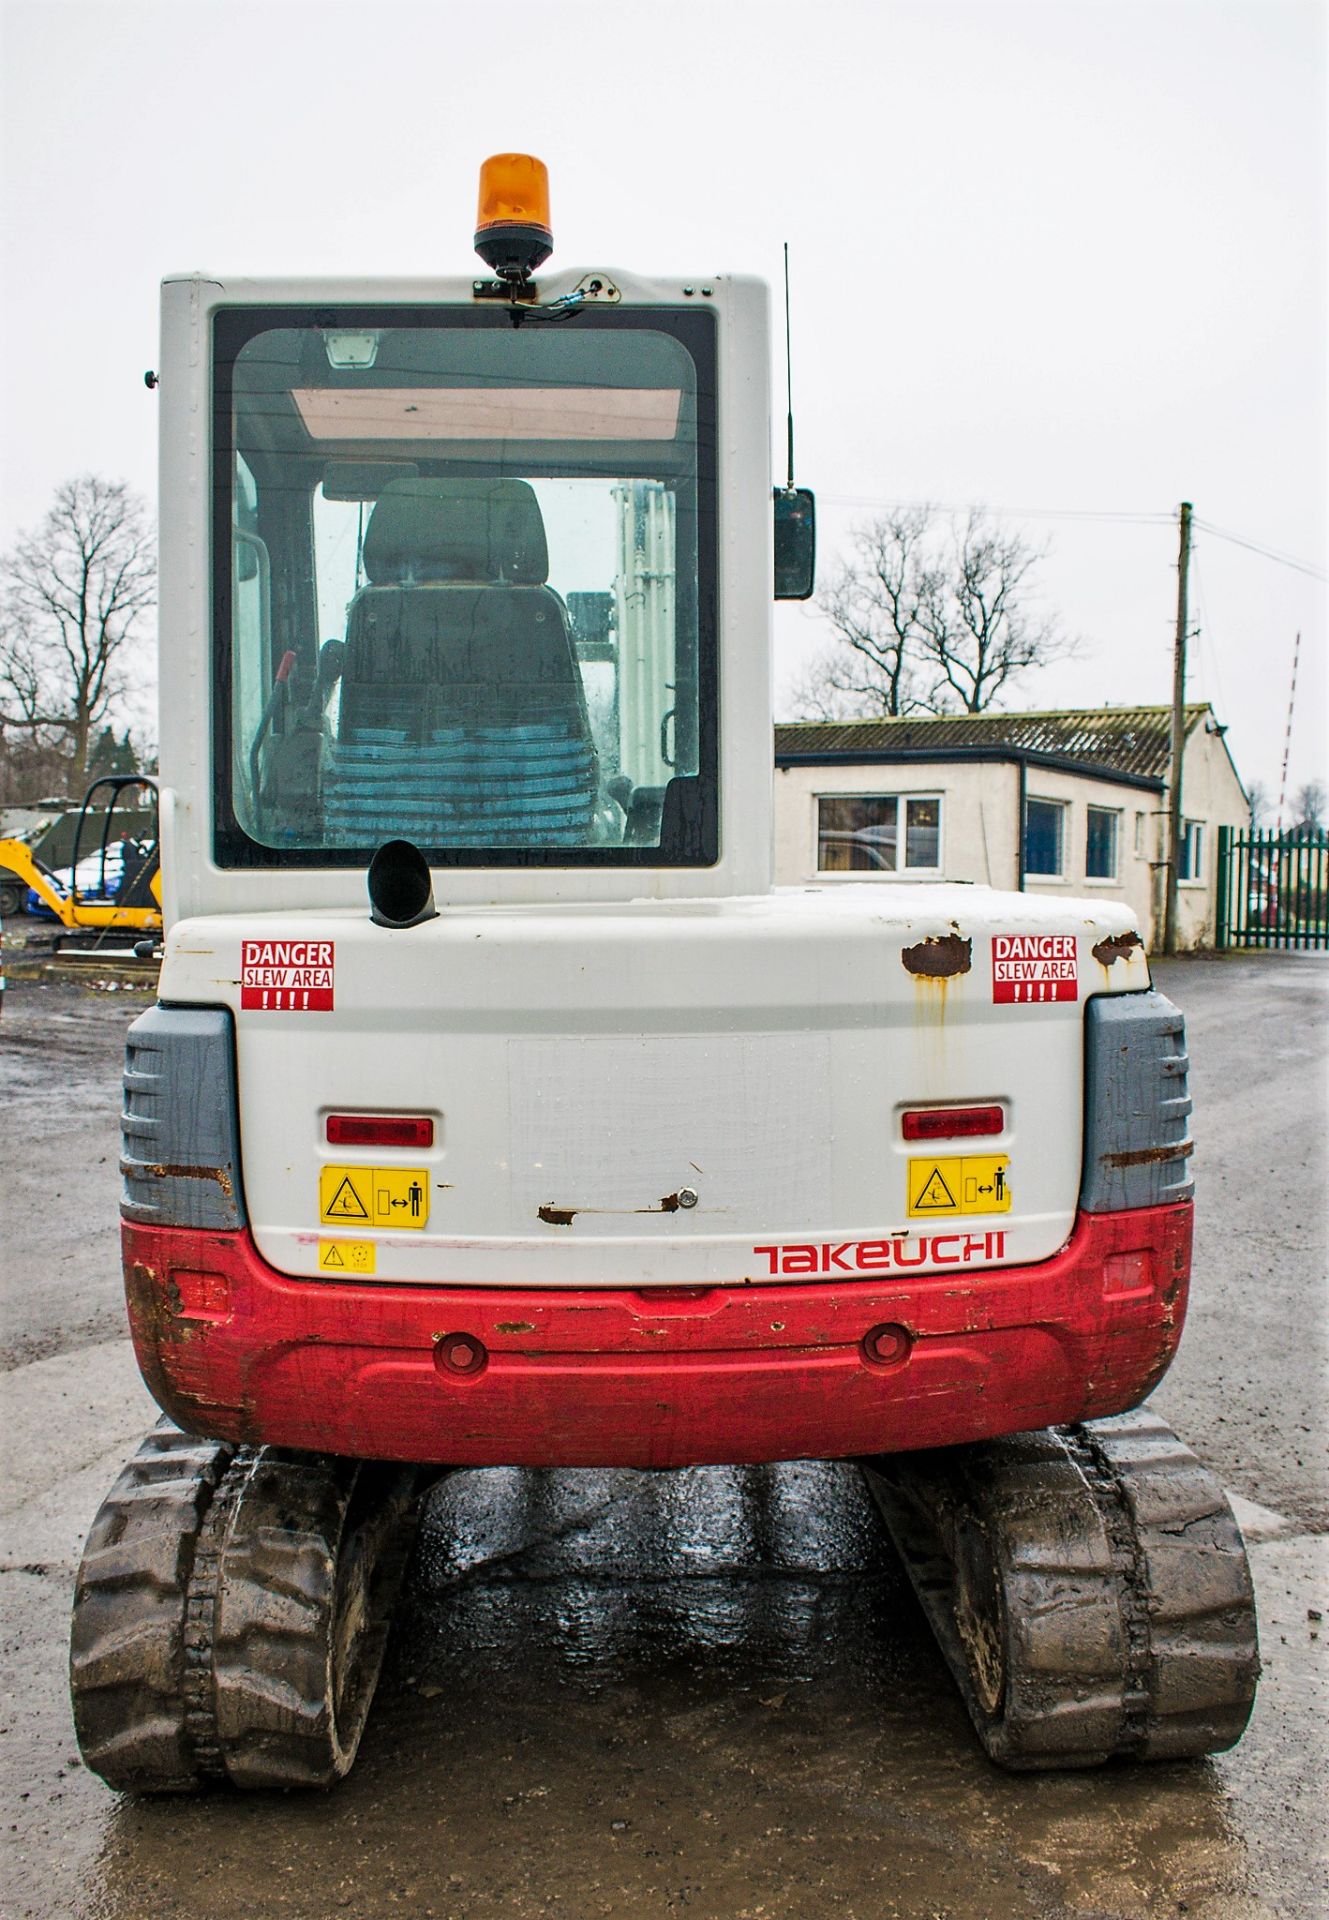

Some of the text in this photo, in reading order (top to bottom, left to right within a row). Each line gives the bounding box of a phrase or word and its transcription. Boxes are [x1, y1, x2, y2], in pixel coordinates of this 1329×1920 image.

[246, 943, 332, 965] DANGER
[996, 937, 1075, 959] DANGER
[246, 969, 331, 987] SLEW AREA
[997, 962, 1075, 980] SLEW AREA
